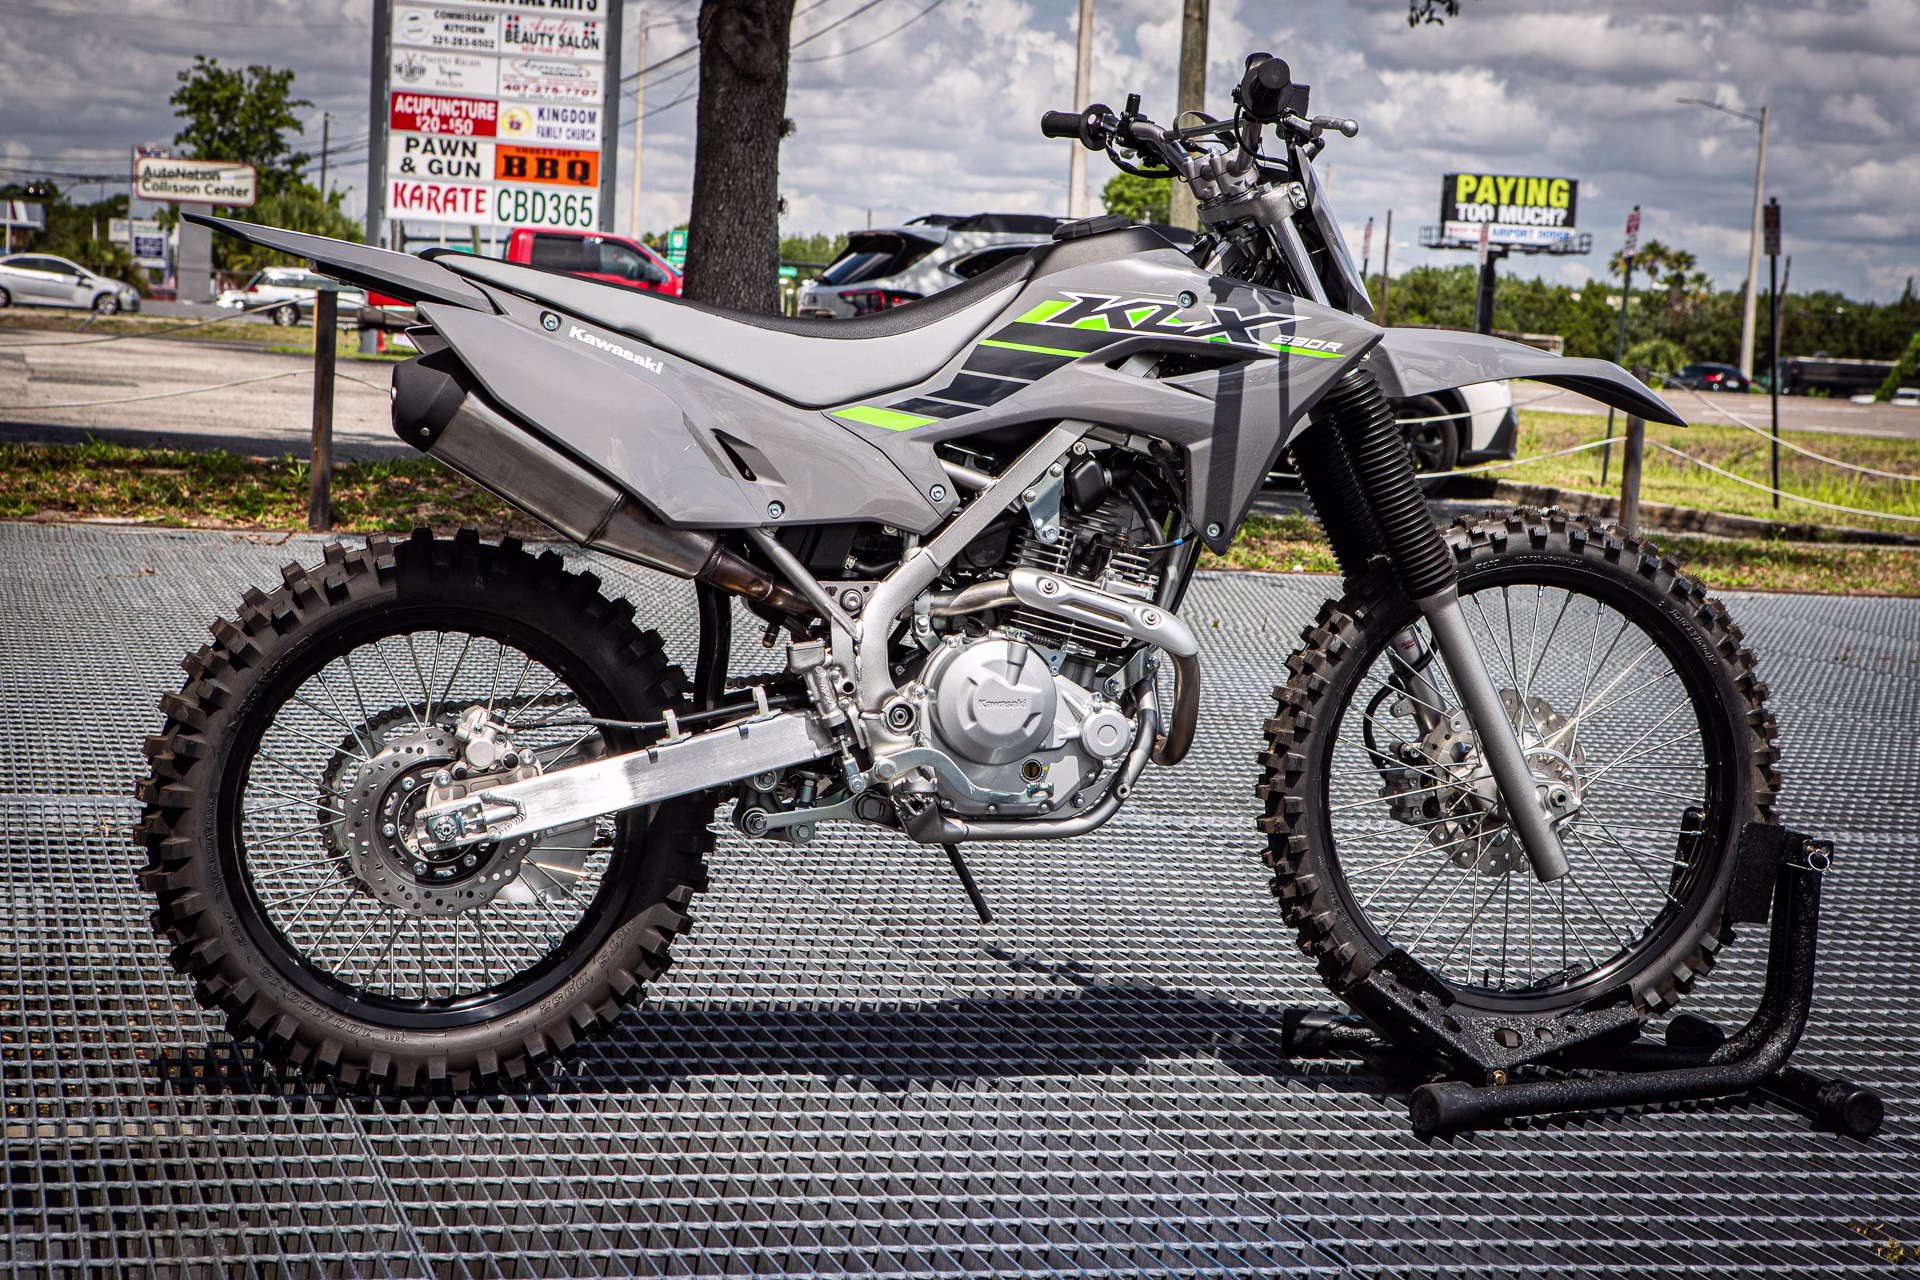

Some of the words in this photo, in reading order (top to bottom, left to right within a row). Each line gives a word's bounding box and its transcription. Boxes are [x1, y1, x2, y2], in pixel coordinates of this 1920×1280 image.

[505, 29, 554, 46] BEAUTY
[558, 34, 599, 50] SALON
[394, 95, 496, 121] ACUPUNCTURE
[538, 107, 597, 124] KINGDOM
[536, 125, 563, 139] FAMILY
[566, 127, 596, 142] CHURCH
[405, 137, 477, 158] PAWN
[143, 165, 221, 181] AutoNation
[400, 157, 416, 174] &
[428, 159, 481, 178] GUN
[502, 155, 590, 185] BBQ
[142, 179, 200, 195] Collision
[204, 183, 249, 198] Center
[393, 182, 487, 214] KARATE
[1456, 173, 1570, 208] PAYING
[497, 189, 593, 227] CBD365
[1455, 202, 1495, 223] TOO
[1498, 204, 1567, 227] MUCH?
[1040, 291, 1311, 352] KLX
[1271, 334, 1344, 353] 230R
[568, 325, 664, 376] Kawasaki
[978, 699, 1027, 709] Kawasaki
[258, 966, 372, 1038] 100/100-18
[539, 972, 590, 1016] D952
